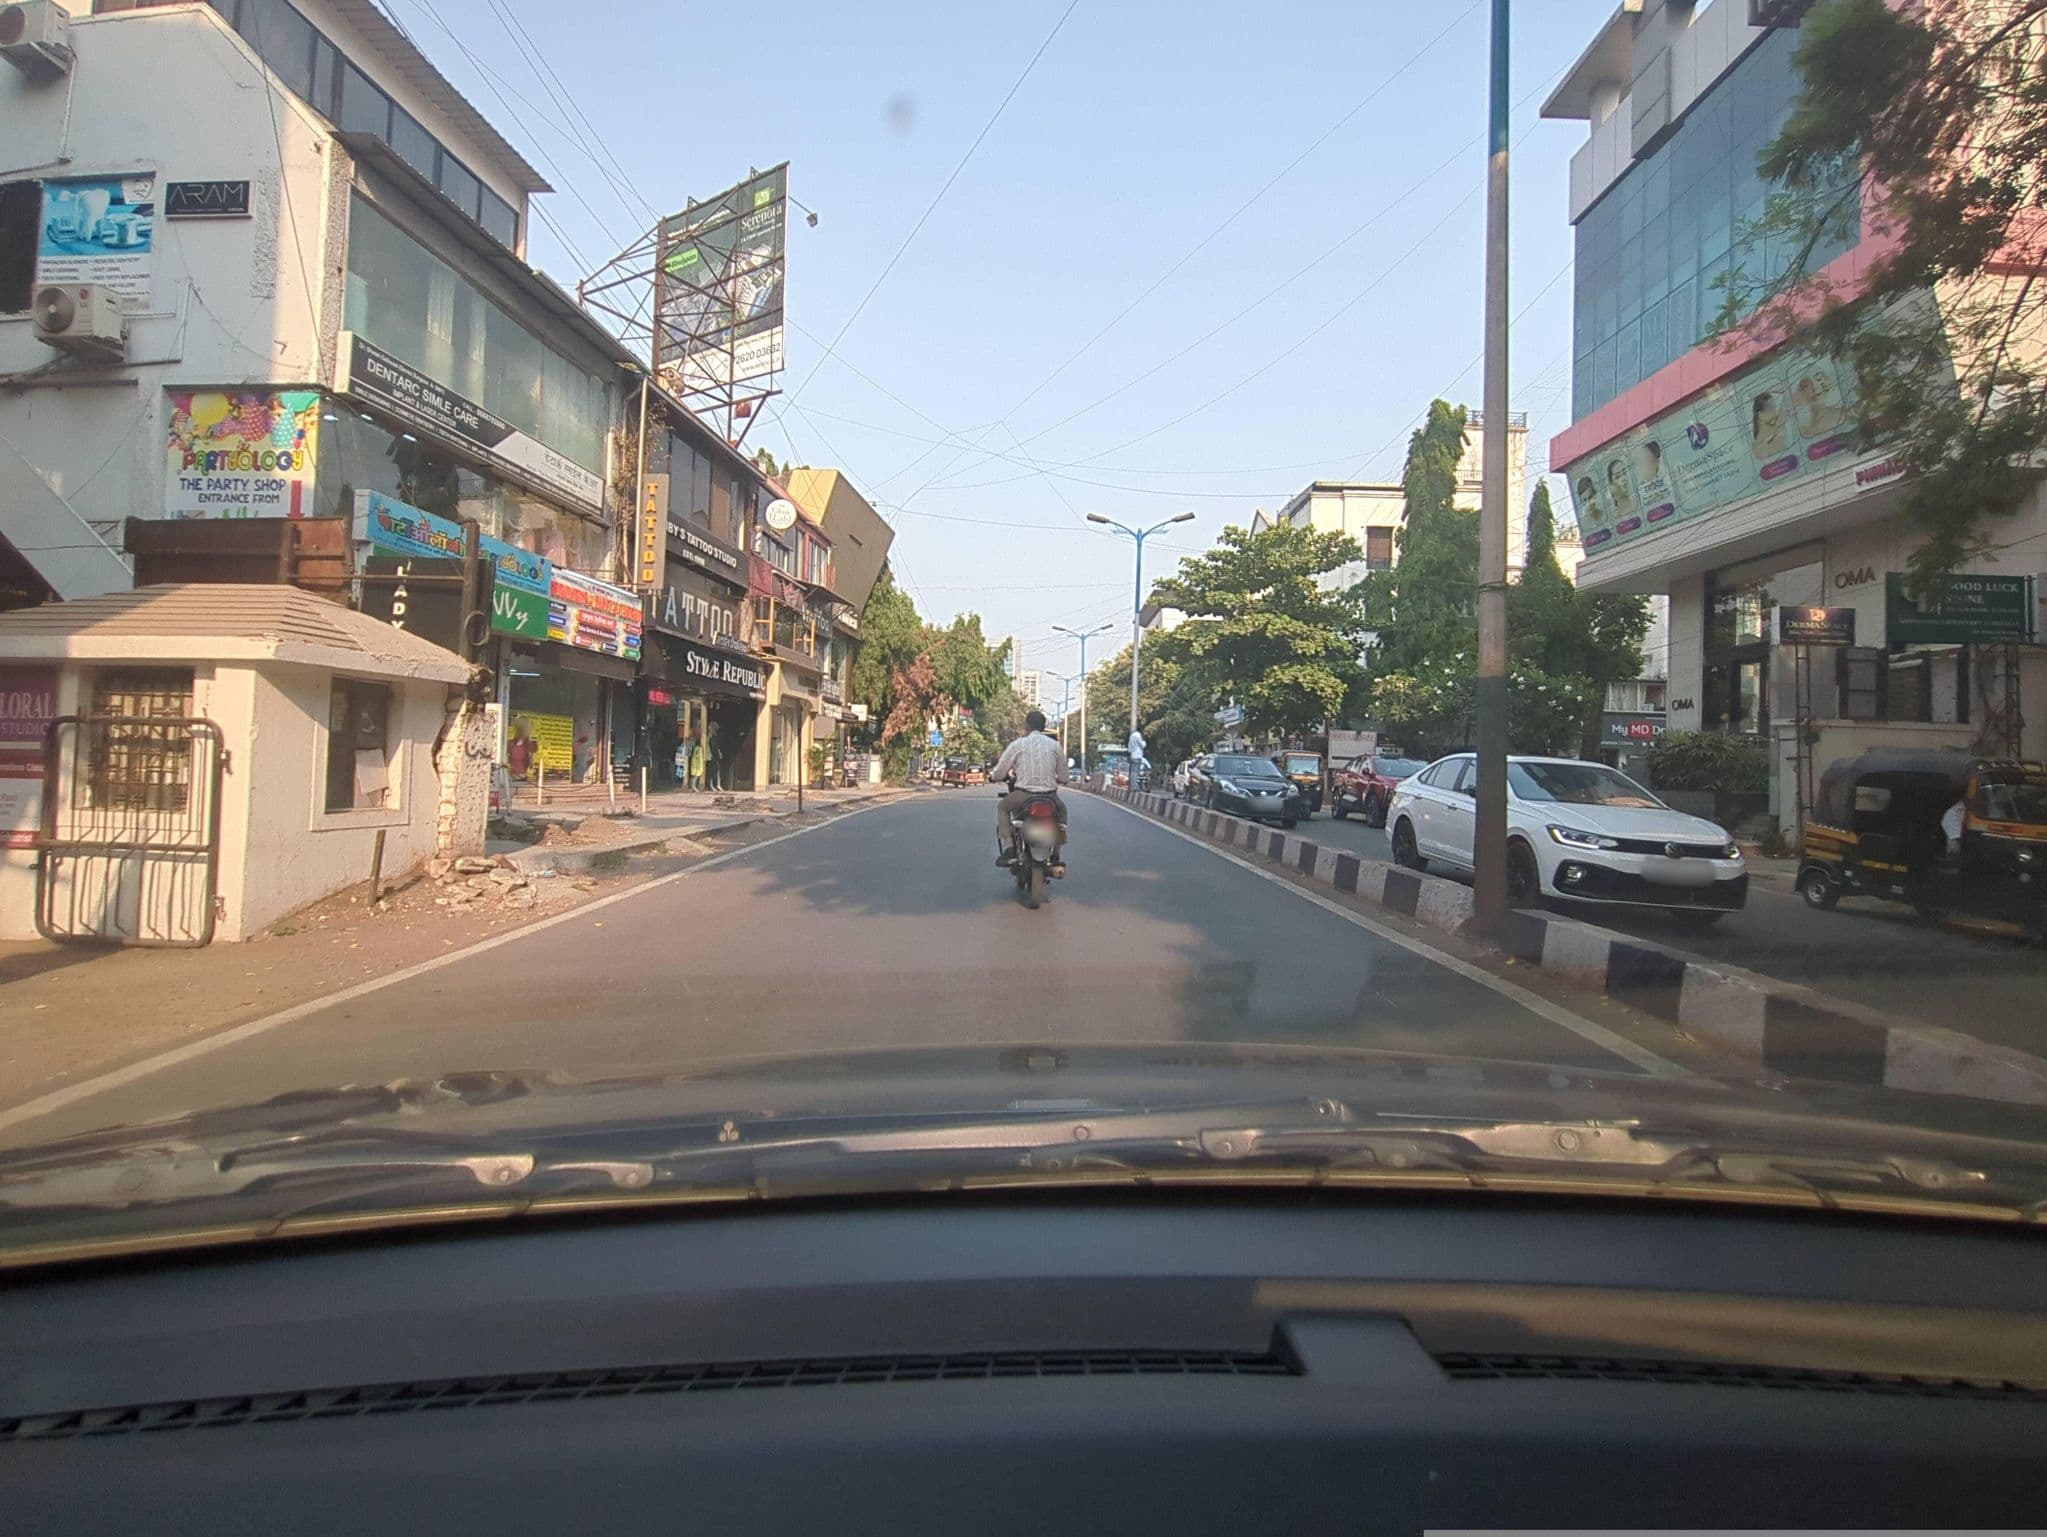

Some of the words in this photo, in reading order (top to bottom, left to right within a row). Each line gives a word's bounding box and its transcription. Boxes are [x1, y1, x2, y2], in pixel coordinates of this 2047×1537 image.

[168, 183, 244, 204] ARAM
[366, 357, 420, 397] DENTARC
[453, 406, 480, 430] CARE
[182, 449, 304, 477] PARTYOLOGY
[179, 477, 203, 492] THE
[206, 478, 249, 492] PARTY
[253, 478, 287, 492] SHOP
[198, 493, 250, 504] ENTRANCE
[252, 494, 281, 504] FROM
[642, 482, 660, 584] TATTOO
[686, 531, 713, 556] TATTOO
[712, 546, 737, 569] STUDIO
[1835, 566, 1876, 590] OMA
[722, 660, 767, 690] REPUBLIC
[1671, 698, 1695, 711] OMA
[1611, 724, 1628, 736] My
[1631, 724, 1650, 735] MD
